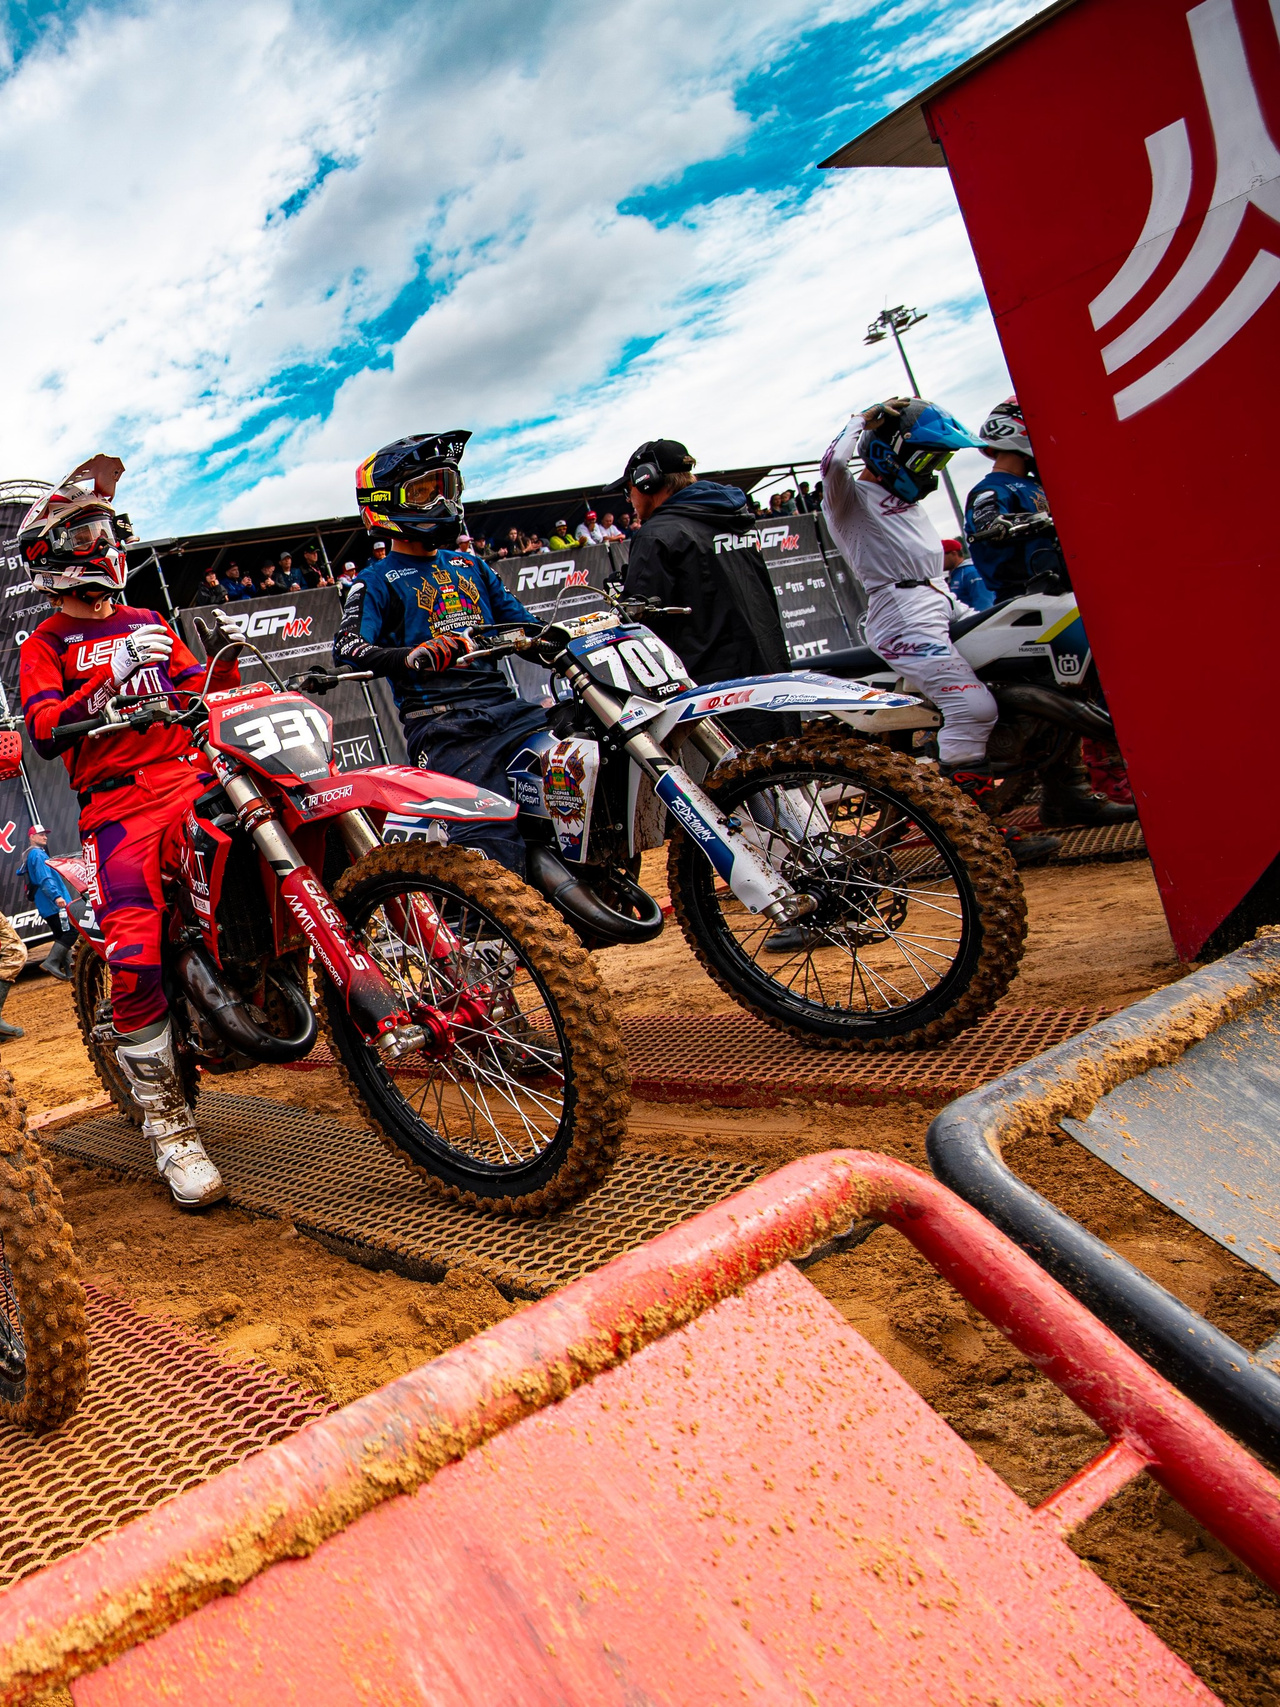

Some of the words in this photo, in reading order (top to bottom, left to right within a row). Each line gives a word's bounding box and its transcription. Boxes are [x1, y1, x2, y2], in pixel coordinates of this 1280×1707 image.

[759, 525, 789, 548] GP
[780, 534, 800, 552] MX
[7, 556, 23, 571] ВТ
[517, 559, 575, 592] RGP
[565, 569, 589, 587] MX
[791, 582, 805, 593] ВТБ
[812, 578, 826, 589] ВТБ
[282, 616, 313, 640] MX
[587, 638, 689, 692] 702
[657, 683, 680, 696] RGP
[221, 703, 247, 719] RGP
[234, 709, 329, 760] 331
[333, 740, 375, 770] CHKI
[300, 767, 327, 779] GASGAS
[321, 784, 353, 804] TOCHKI
[302, 879, 370, 971] GASS
[308, 932, 344, 987] MOTORSPORTS
